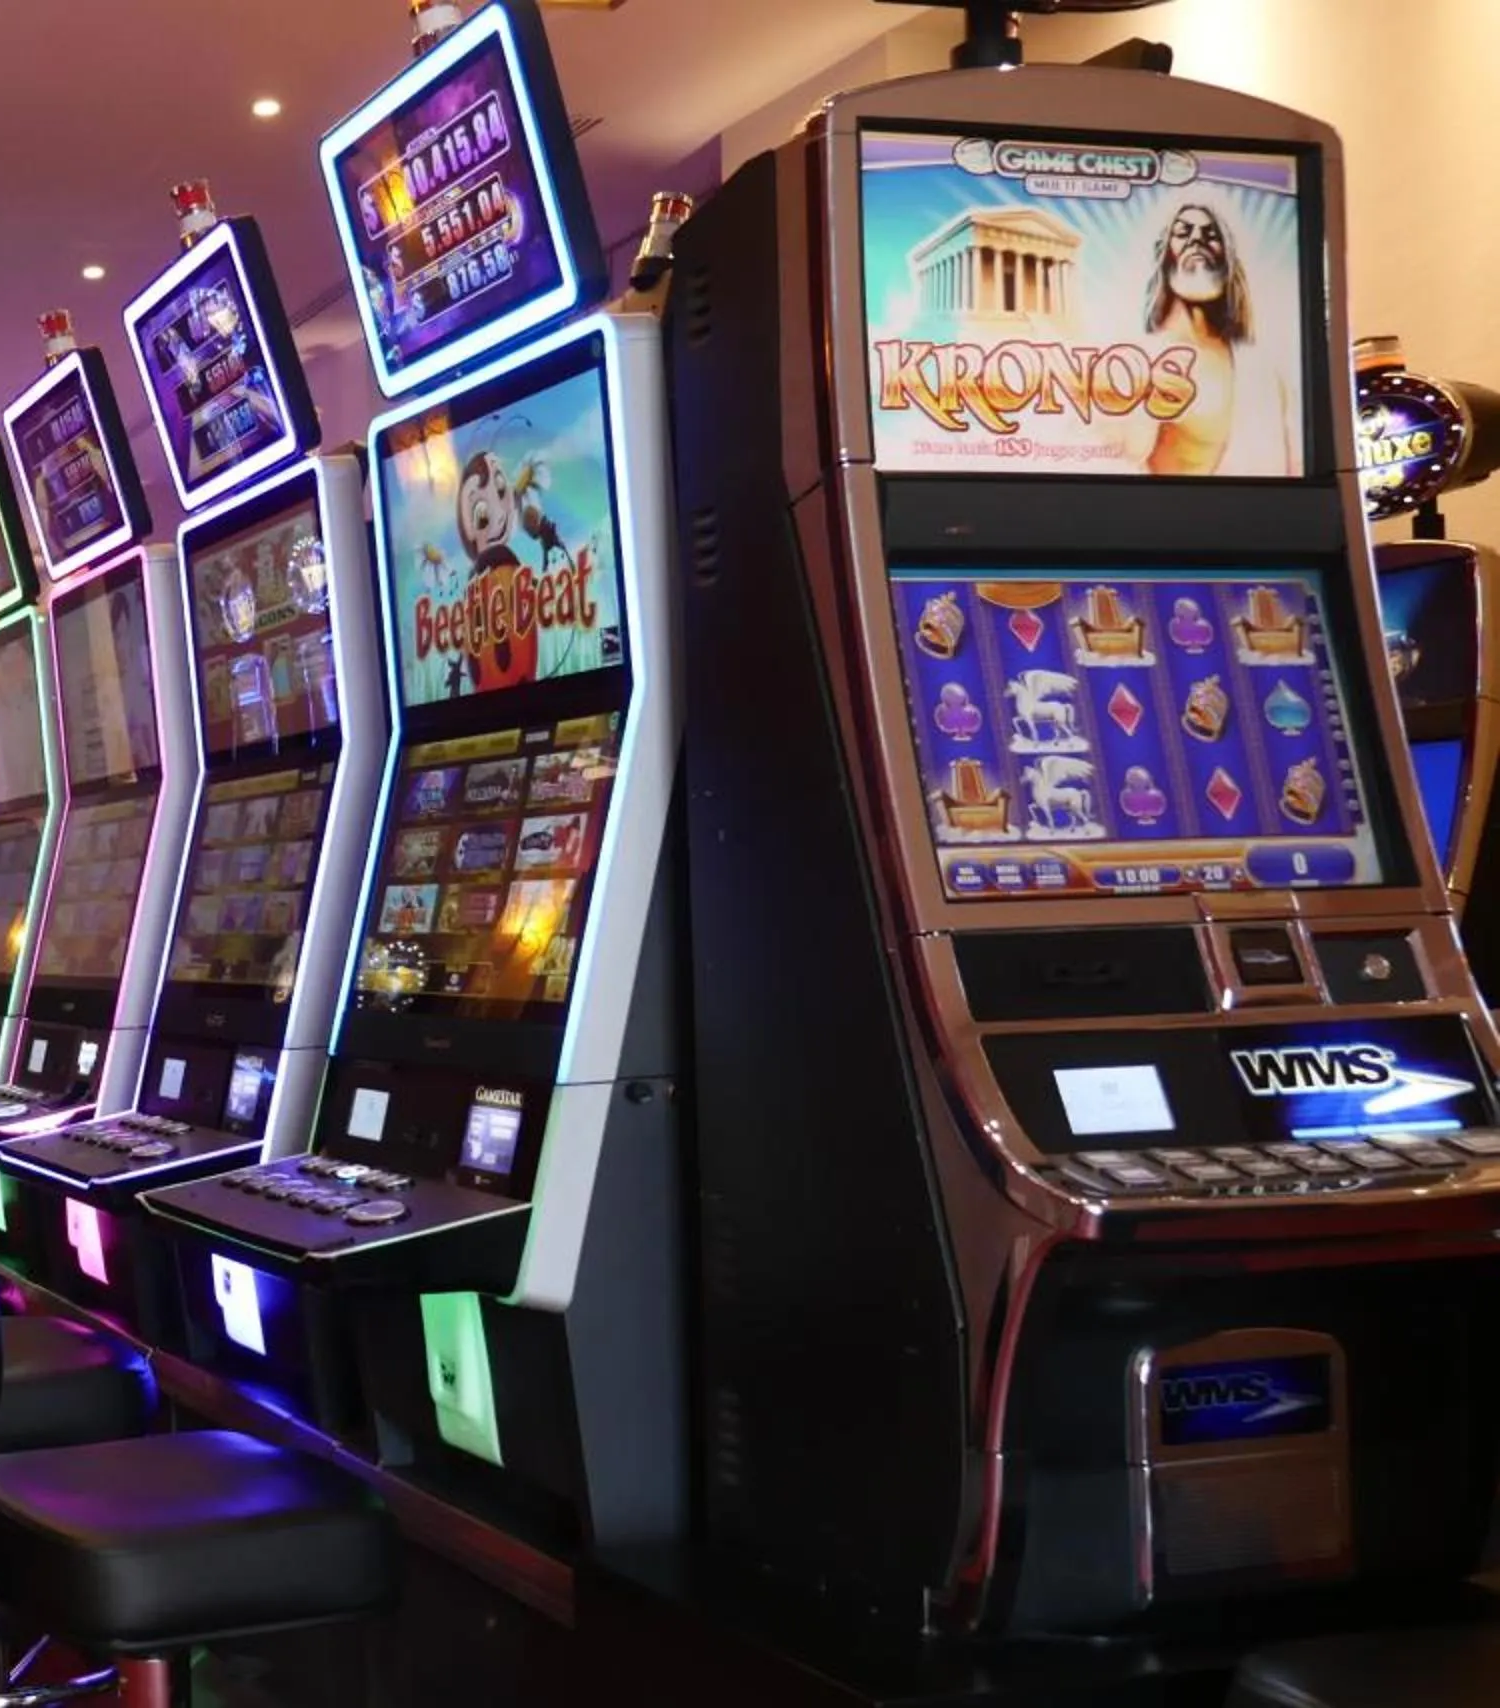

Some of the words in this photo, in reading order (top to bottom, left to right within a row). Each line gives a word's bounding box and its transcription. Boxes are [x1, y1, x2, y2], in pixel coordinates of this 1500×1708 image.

[1000, 149, 1075, 173] GAME
[1078, 153, 1153, 177] CHEST
[873, 340, 1198, 434] KRONOS
[414, 567, 510, 661] Beetle
[511, 542, 597, 640] Beat
[1203, 865, 1223, 880] 20
[1291, 852, 1309, 875] 0
[1232, 1046, 1393, 1095] WMS
[1161, 1375, 1272, 1413] WMS
